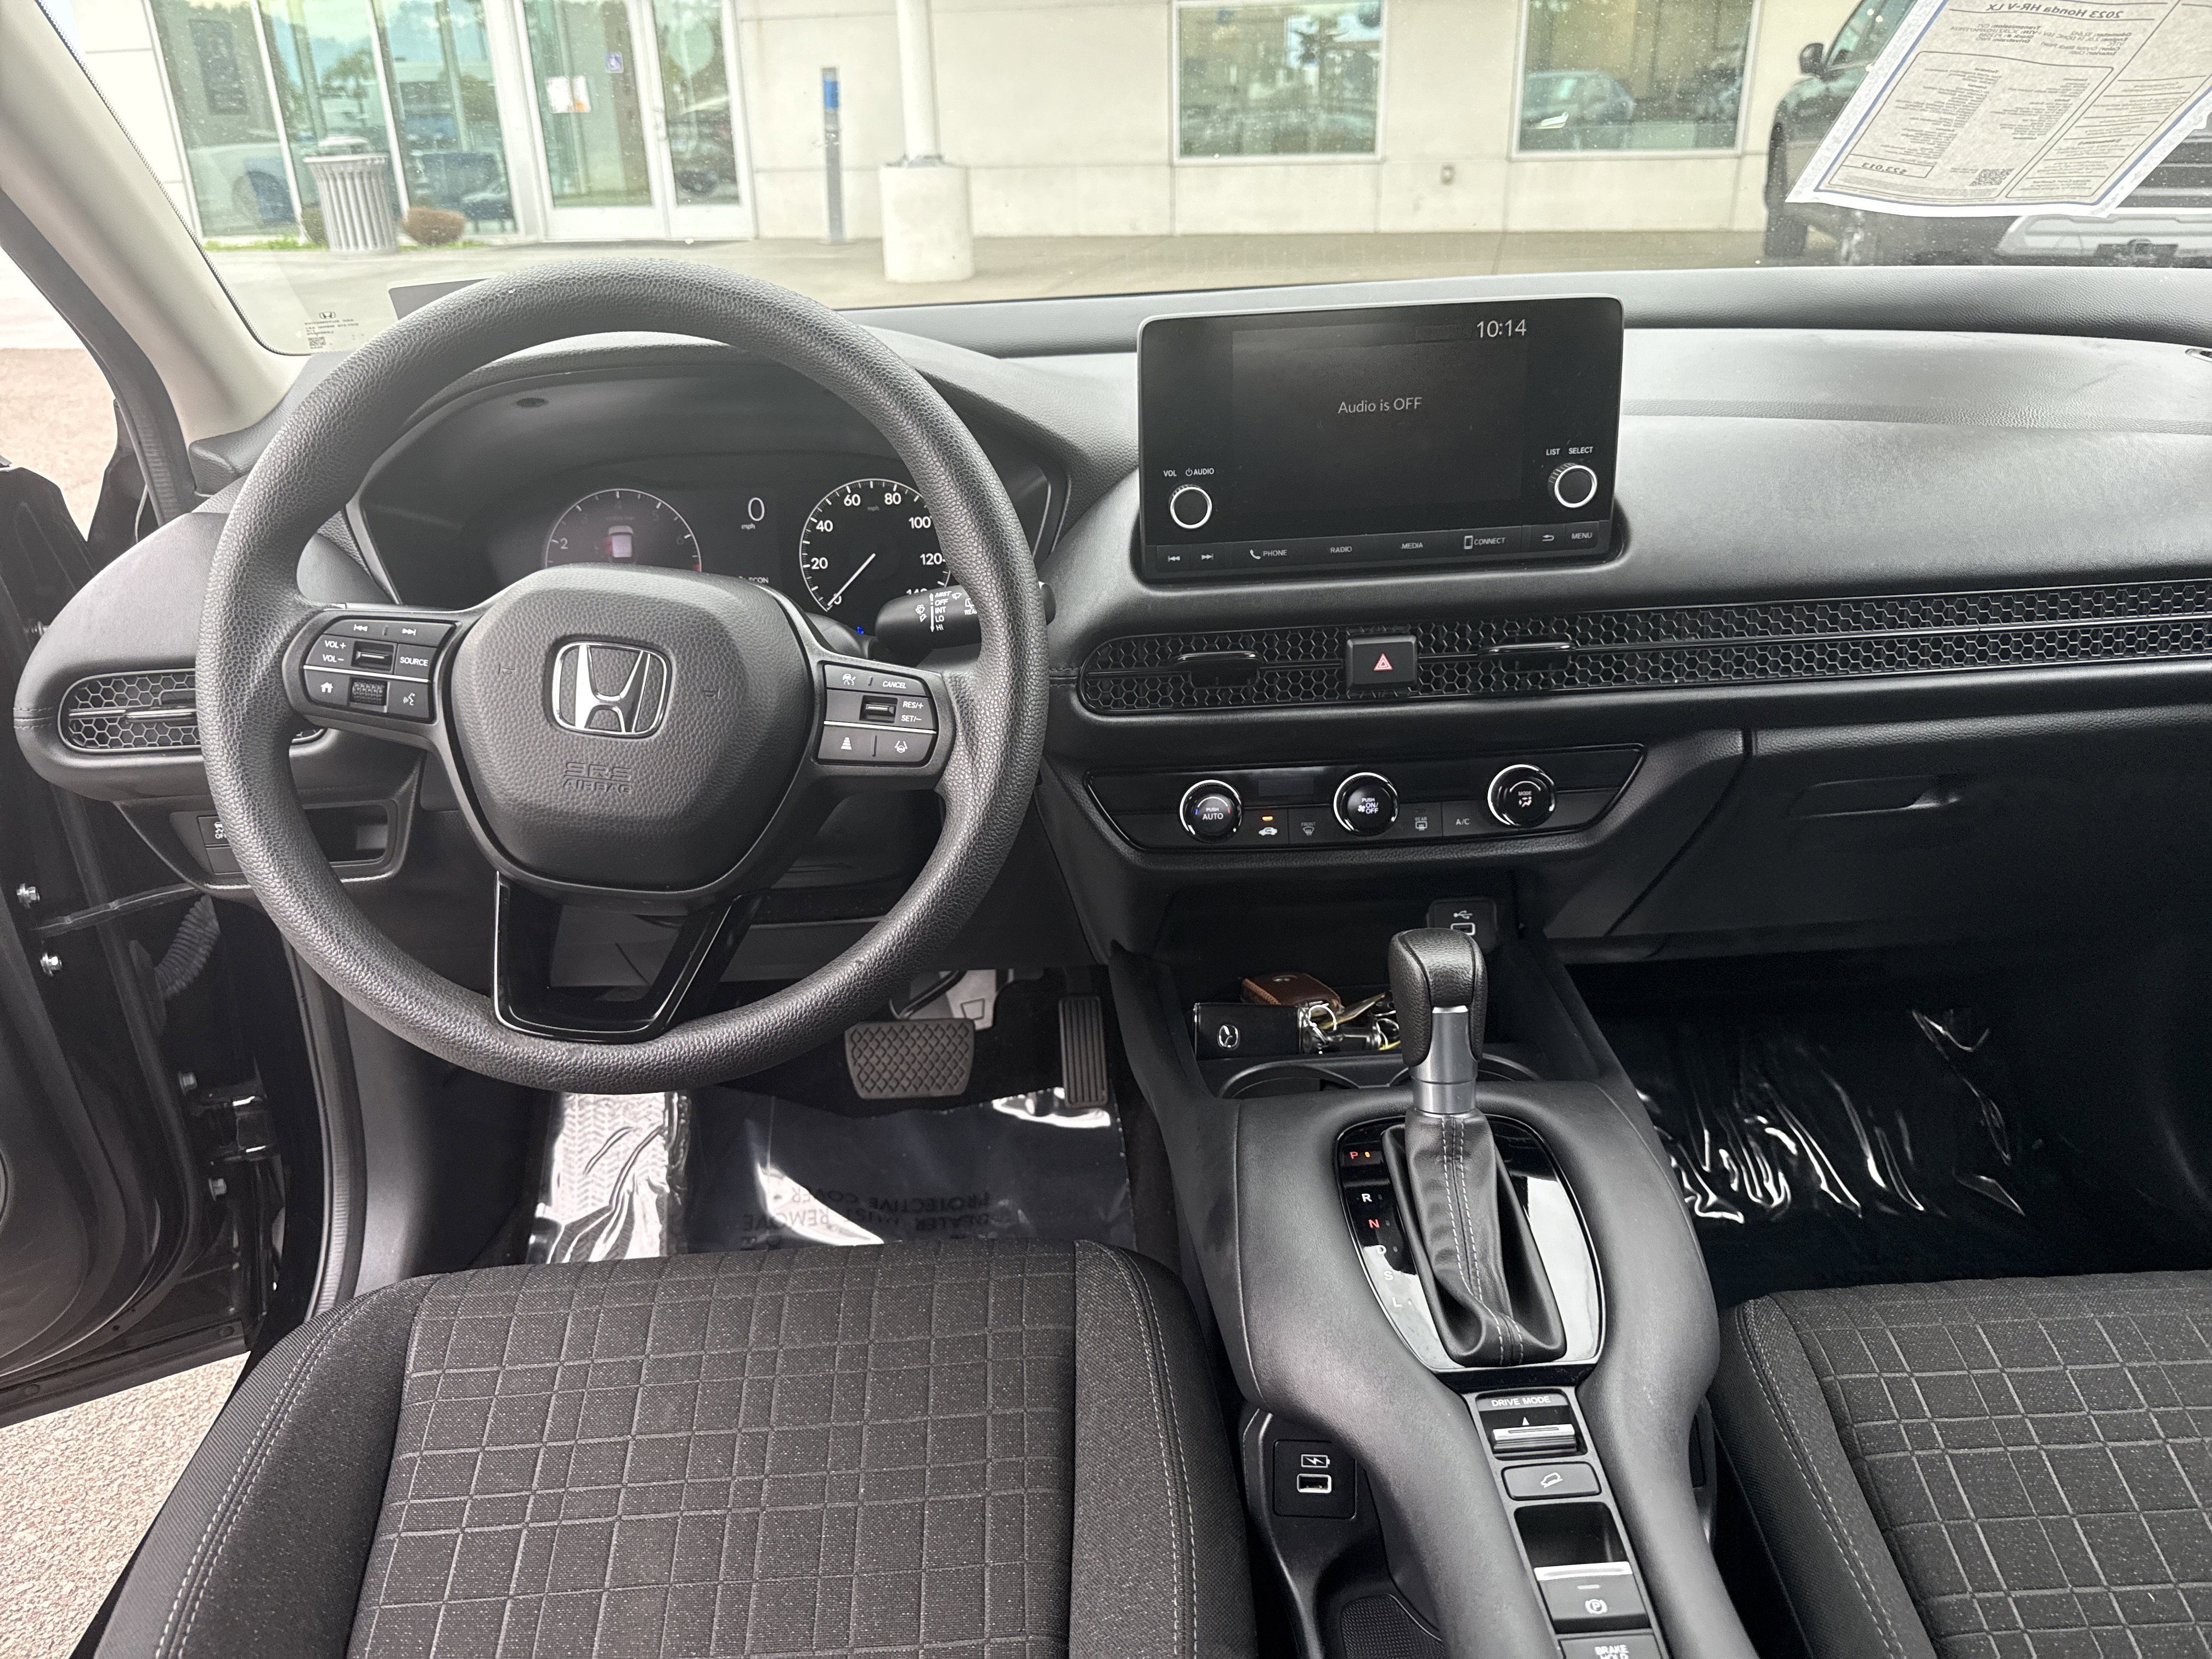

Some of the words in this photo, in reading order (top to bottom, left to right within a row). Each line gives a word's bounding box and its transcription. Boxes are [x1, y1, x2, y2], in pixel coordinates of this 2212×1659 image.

[1476, 319, 1527, 338] 10:14
[1338, 400, 1376, 414] Audio
[1380, 399, 1390, 411] is
[1393, 397, 1422, 410] OFF
[1568, 446, 1593, 455] SELECT
[1193, 467, 1215, 476] AUDIO
[844, 493, 861, 506] 60
[884, 492, 901, 505] 80
[748, 497, 765, 521] 0
[816, 520, 833, 532] 40
[909, 516, 932, 529] 100
[560, 538, 569, 549] 2
[1474, 537, 1505, 545] CONNECT
[811, 557, 828, 569] 20
[919, 553, 943, 566] 120
[399, 656, 428, 667] SOURCE
[565, 761, 631, 780] SRS
[563, 778, 631, 794] AIRBAG
[1362, 1193, 1373, 1202] R
[1368, 1218, 1380, 1228] N
[1376, 1245, 1387, 1255] D
[1384, 1270, 1393, 1281] S
[1392, 1297, 1402, 1307] L
[1491, 1398, 1520, 1407] DRIVE
[1522, 1396, 1551, 1404] MODE
[1594, 1644, 1629, 1655] BRAKE
